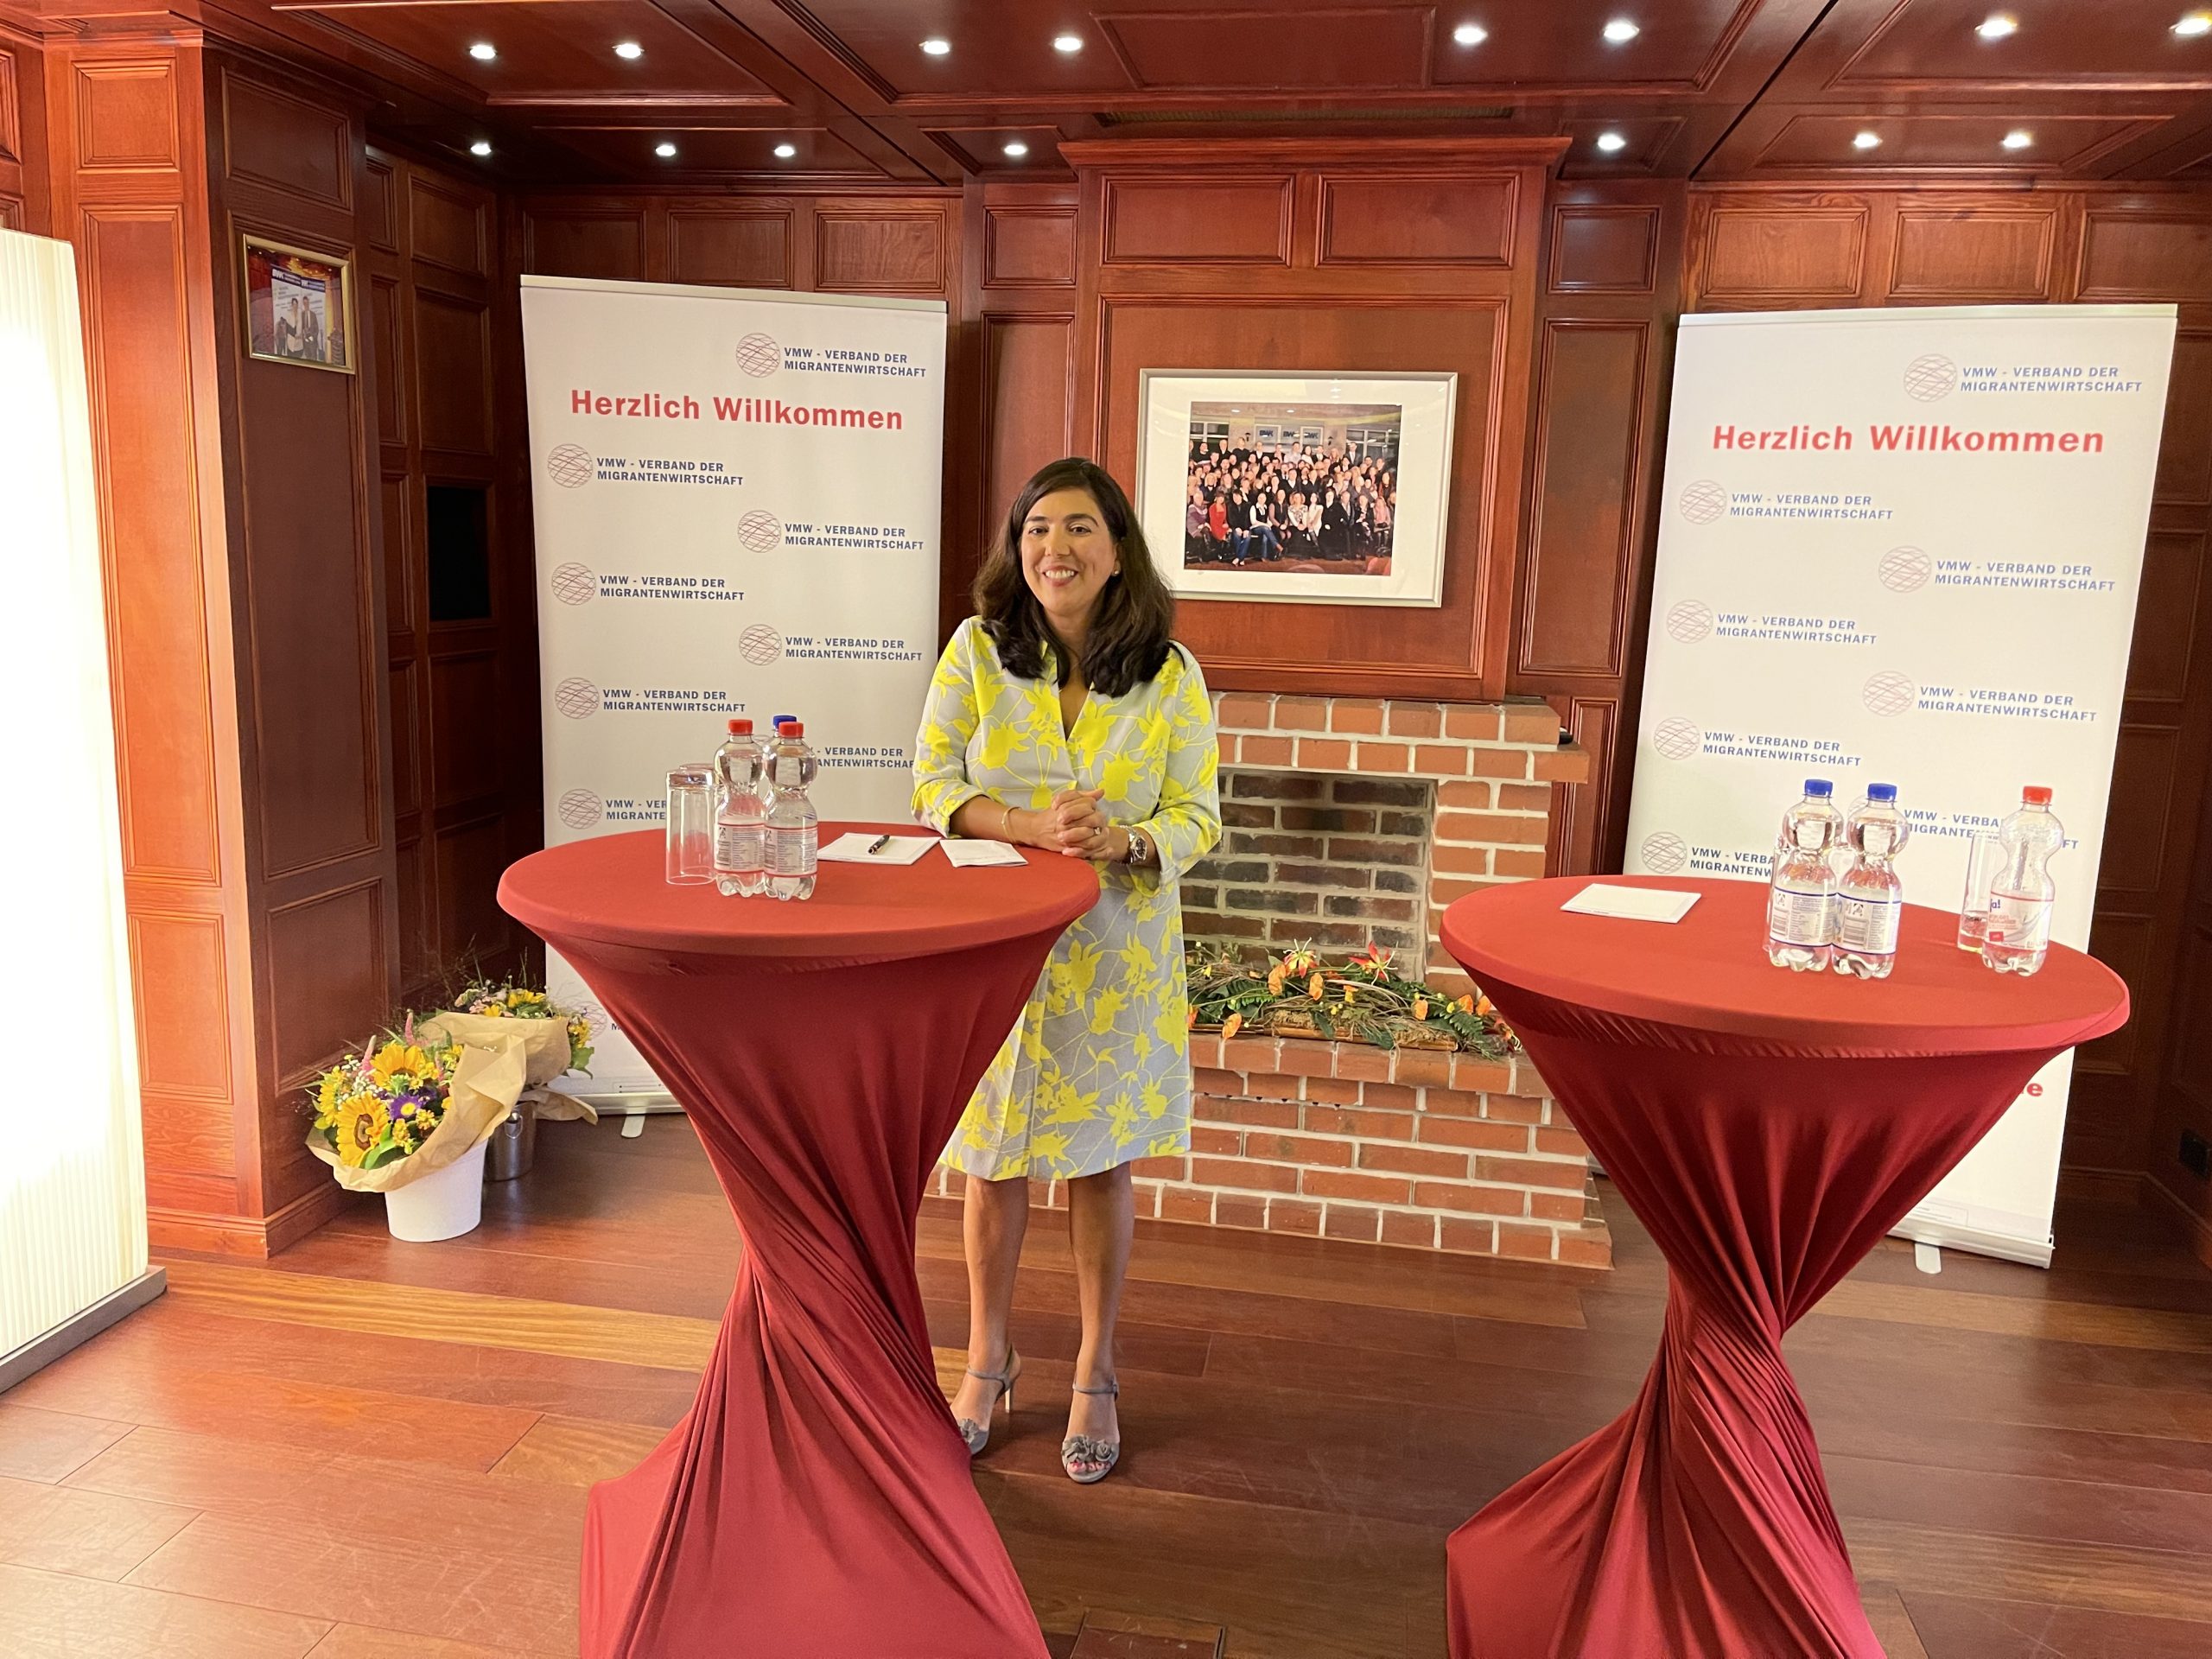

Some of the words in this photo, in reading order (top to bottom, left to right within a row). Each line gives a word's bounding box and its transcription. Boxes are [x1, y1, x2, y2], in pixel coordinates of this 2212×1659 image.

[785, 347, 813, 358] VMW
[825, 350, 880, 362] VERBAND
[885, 353, 907, 363] DER
[785, 360, 926, 377] MIGRANTENWIRTSCHAFT
[1963, 367, 1998, 378] VMW
[2014, 367, 2082, 378] VERBAND
[2088, 367, 2119, 378] DER
[1961, 381, 2143, 392] MIGRANTENWIRTSCHAFT
[571, 390, 700, 419] Herzlich
[713, 397, 902, 429] Willkommen
[1713, 425, 1853, 450] Herzlich
[1870, 425, 2103, 453] Willkommen
[597, 458, 626, 467] VMW
[639, 460, 695, 471] VERBAND
[701, 462, 724, 472] DER
[598, 471, 743, 485] MIGRANTENWIRTSCHAFT
[1732, 493, 1764, 503] VMW
[1777, 494, 1840, 505] VERBAND
[1845, 496, 1872, 505] DER
[1730, 507, 1893, 519] MIGRANTENWIRTSCHAFT
[785, 524, 813, 533] VMW
[825, 525, 879, 536] VERBAND
[883, 528, 906, 537] DER
[785, 536, 924, 550] MIGRANTENWIRTSCHAFT
[1937, 561, 1972, 571] VMW
[1987, 563, 2056, 574] VERBAND
[2063, 566, 2092, 575] DER
[600, 575, 629, 584] VMW
[642, 577, 697, 587] VERBAND
[702, 579, 725, 588] DER
[1936, 575, 2116, 592] MIGRANTENWIRTSCHAFT
[600, 588, 744, 601] MIGRANTENWIRTSCHAFT
[1719, 614, 1749, 624] VMW
[1763, 616, 1823, 628] VERBAND
[1829, 620, 1856, 629] DER
[785, 637, 813, 645] VMW
[825, 639, 878, 647] VERBAND
[882, 639, 905, 648] DER
[1717, 627, 1877, 644] MIGRANTENWIRTSCHAFT
[785, 649, 923, 660] MIGRANTENWIRTSCHAFT
[603, 690, 632, 698] VMW
[644, 690, 699, 699] VERBAND
[703, 691, 727, 700] DER
[1921, 686, 1954, 697] VMW
[1970, 690, 2038, 702] VERBAND
[2044, 695, 2074, 705] DER
[603, 702, 746, 712] MIGRANTENWIRTSCHAFT
[1917, 700, 2097, 721] MIGRANTENWIRTSCHAFT
[1705, 732, 1735, 742] VMW
[1749, 735, 1808, 748] VERBAND
[1815, 741, 1840, 751] DER
[825, 747, 877, 756] VERBAND
[881, 748, 903, 757] DER
[1702, 745, 1861, 766] MIGRANTENWIRTSCHAFT
[817, 759, 914, 768] ANTENWIRTSCHAF
[606, 800, 634, 809] VMW
[1904, 810, 1937, 821] VMW
[1953, 814, 1999, 828] VERBA
[1692, 847, 1721, 859] VMW
[1735, 852, 1775, 864] VERBA
